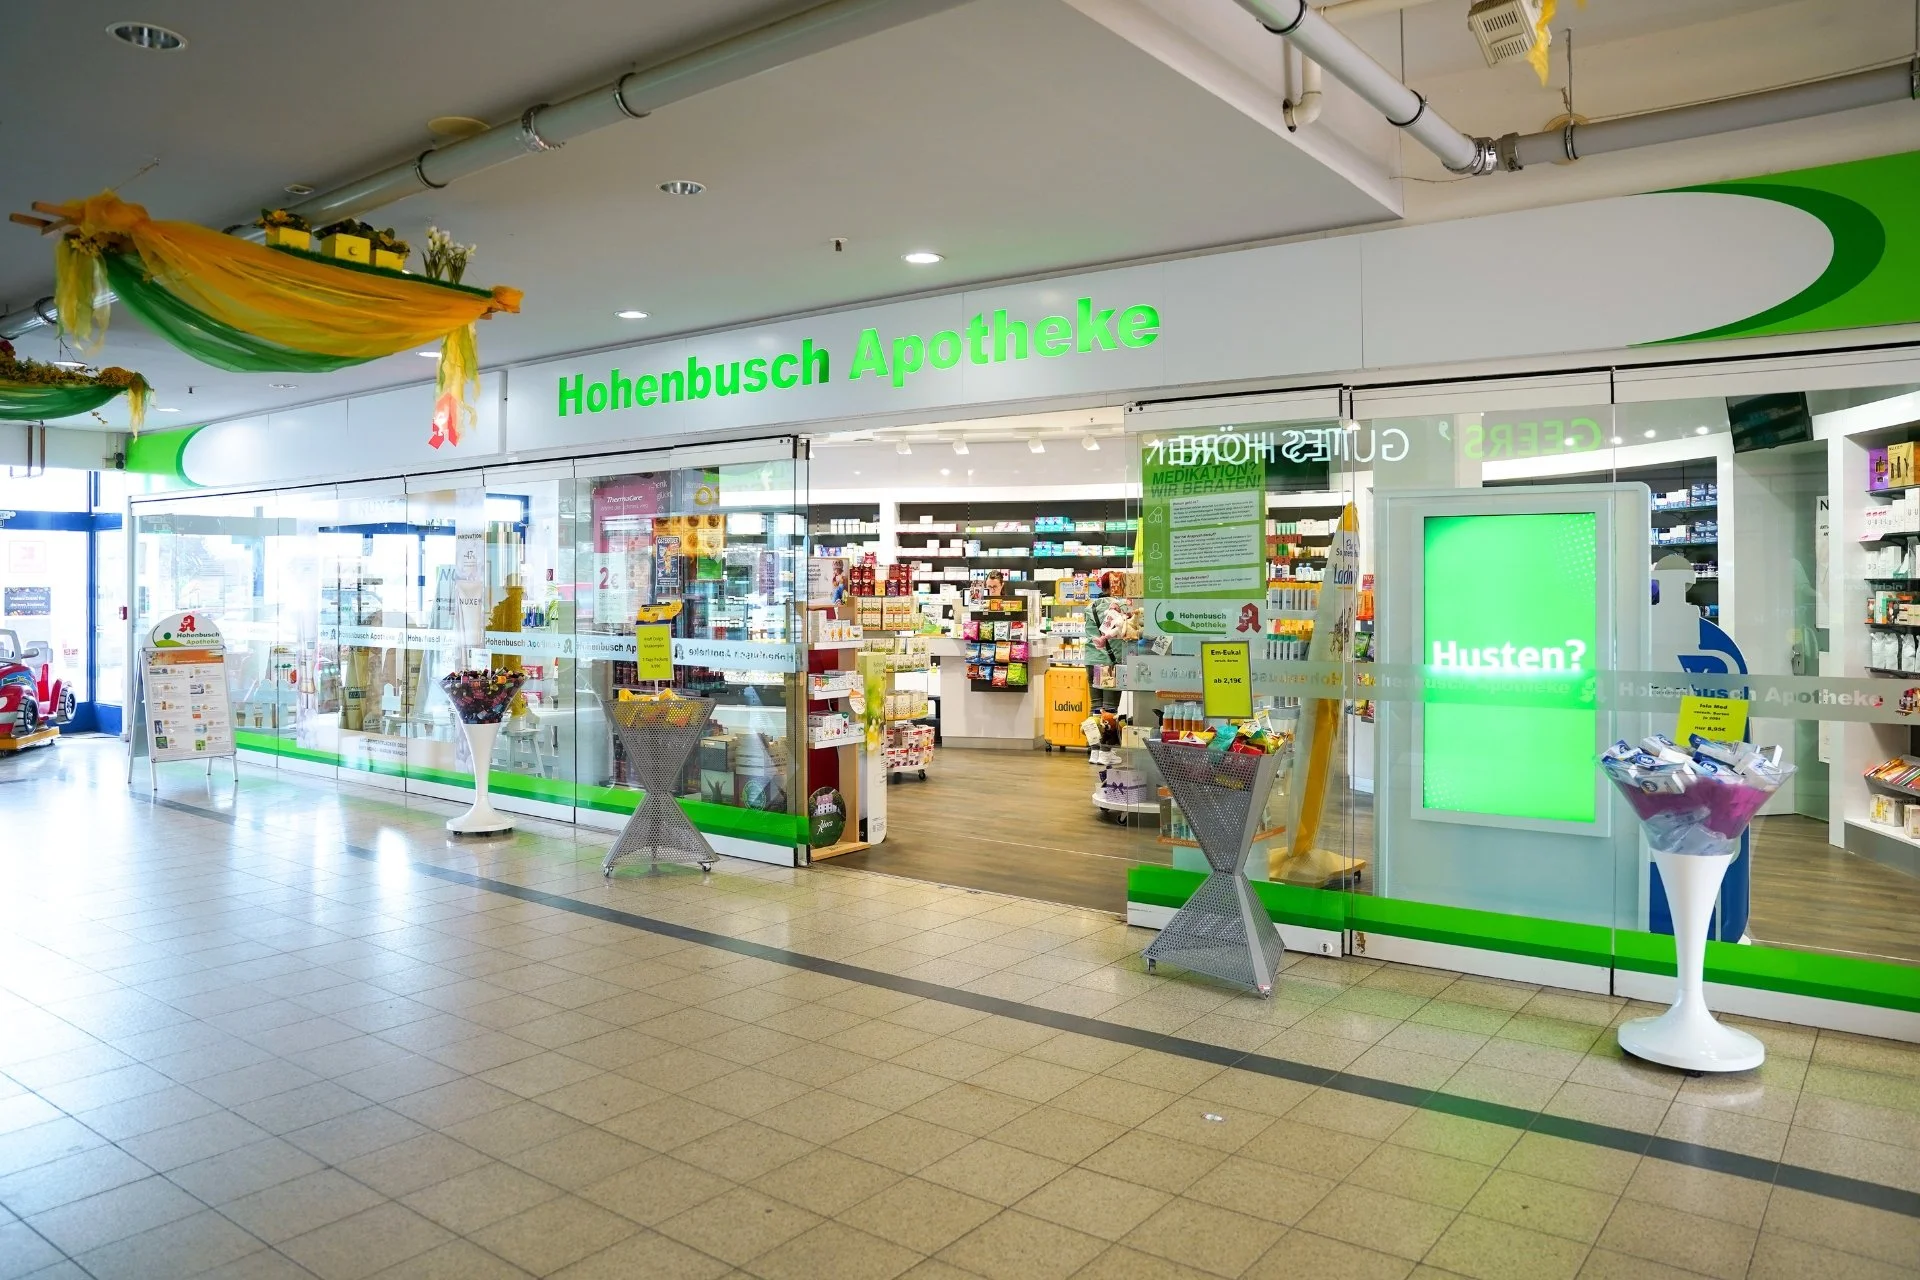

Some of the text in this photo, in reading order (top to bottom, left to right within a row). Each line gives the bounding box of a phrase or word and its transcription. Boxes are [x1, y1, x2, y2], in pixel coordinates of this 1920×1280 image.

[558, 297, 1160, 417] Hohenbusch Apotheke
[1152, 462, 1257, 485] MEDIKATION?
[1151, 474, 1262, 498] WIR BERATEN!
[606, 494, 643, 503] ThermaCare
[1179, 612, 1227, 620] Hohenbusch
[1190, 621, 1227, 629] Apotheke
[1432, 639, 1587, 672] Husten?
[1618, 681, 1757, 700] Hohenbusch
[1765, 687, 1882, 708] Apotheke
[1054, 700, 1083, 713] Ladival
